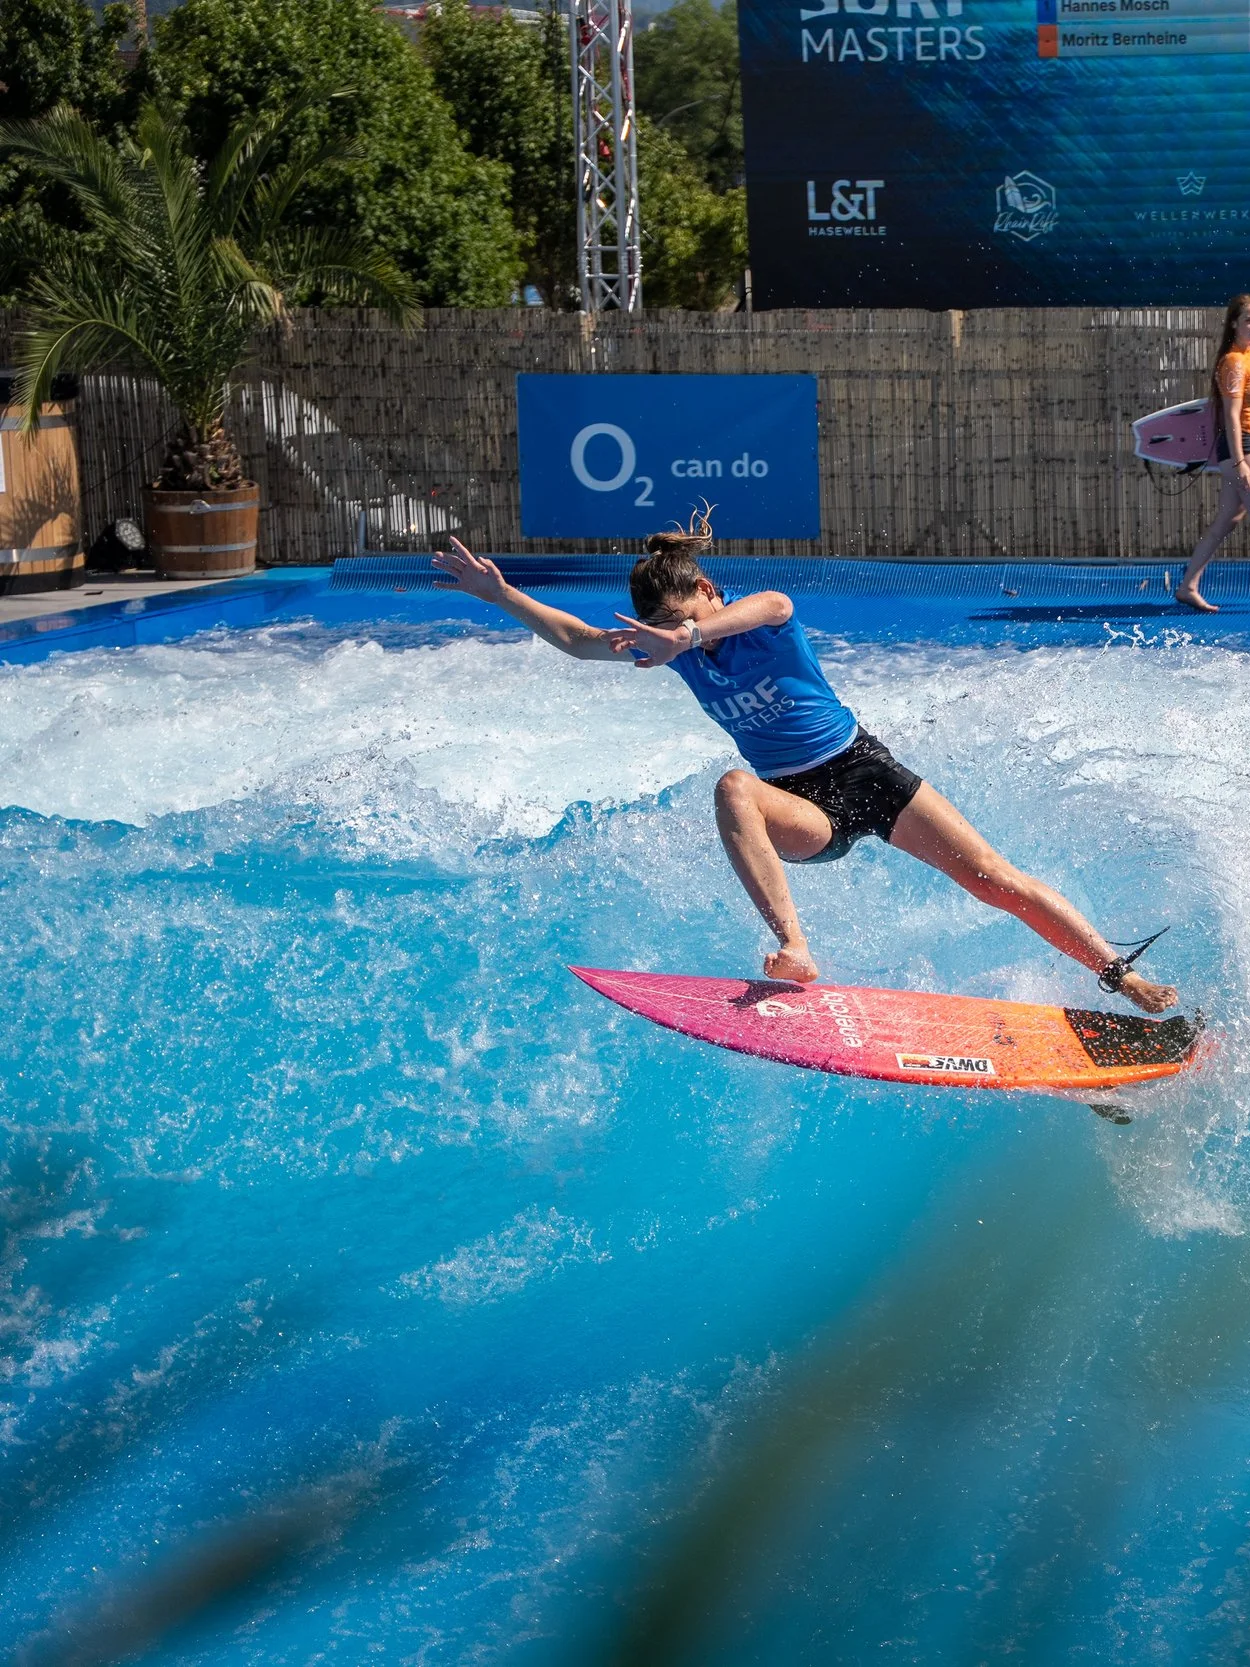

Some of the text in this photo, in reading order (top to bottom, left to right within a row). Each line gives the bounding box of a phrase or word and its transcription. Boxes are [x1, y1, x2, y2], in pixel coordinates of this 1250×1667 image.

[1061, 0, 1116, 12] Hannes
[801, 26, 987, 63] MASTERS
[1061, 31, 1187, 47] Moritz Bernheine
[807, 180, 885, 221] L&T
[808, 226, 887, 236] HASEWELLE
[671, 459, 722, 478] can
[731, 453, 769, 478] do
[820, 989, 862, 1048] enercity
